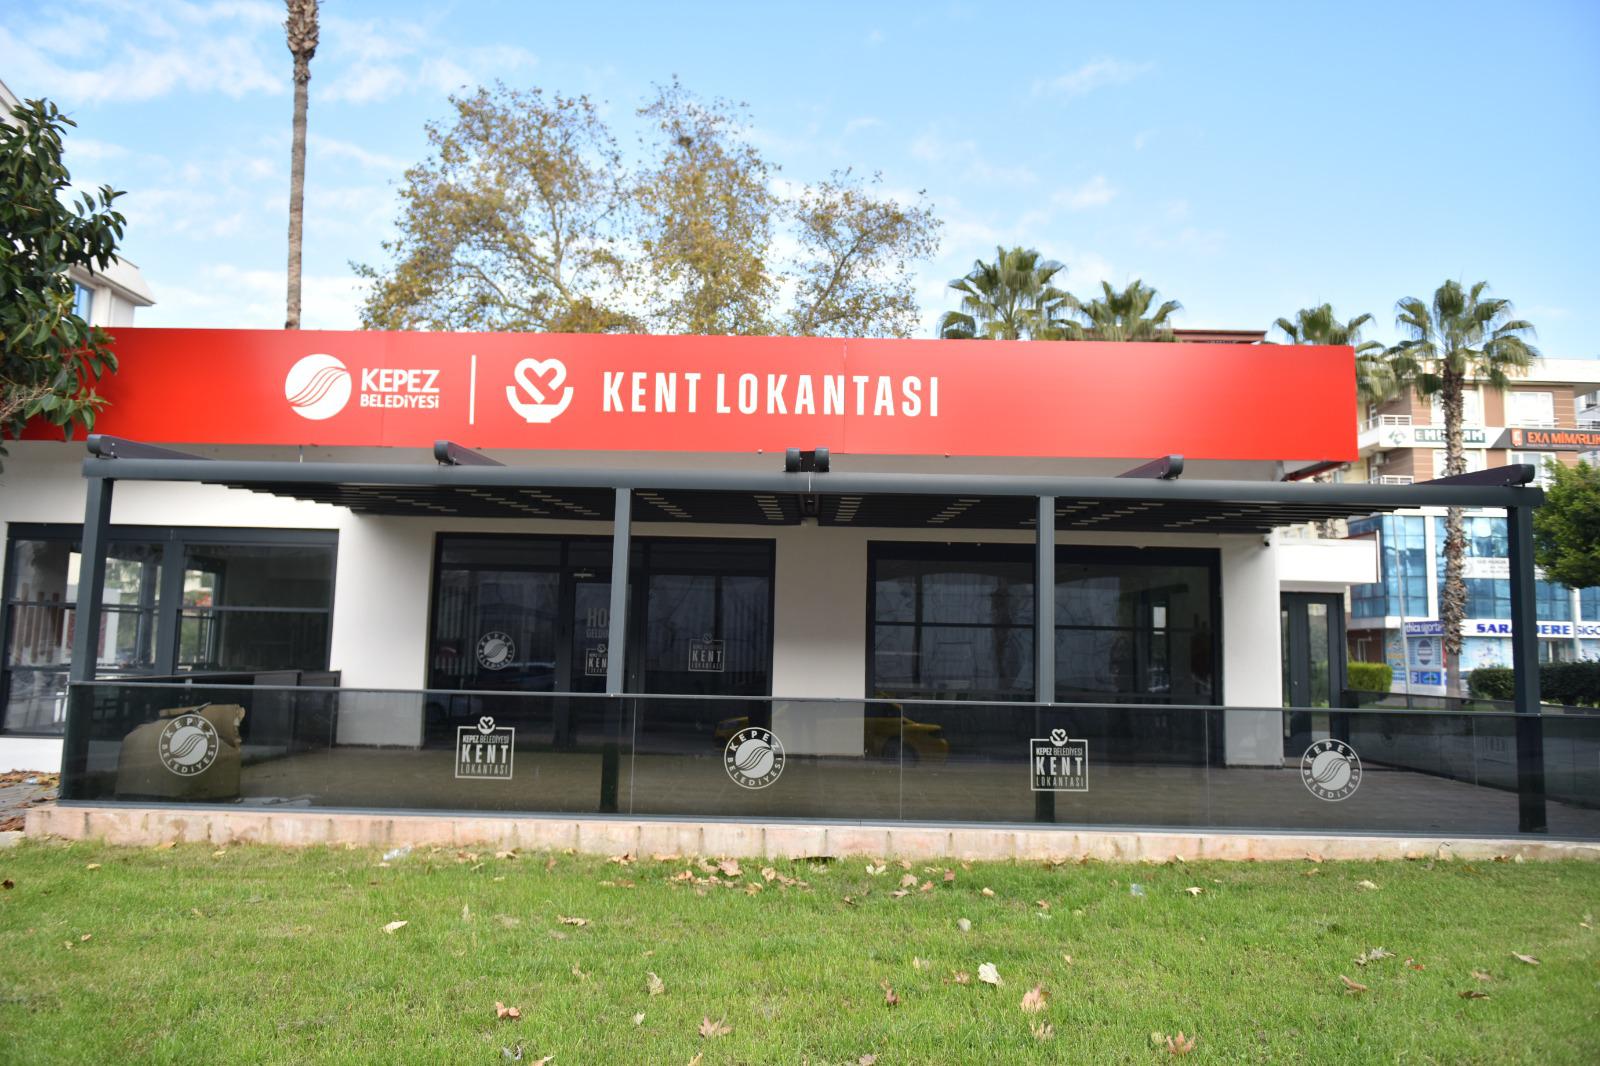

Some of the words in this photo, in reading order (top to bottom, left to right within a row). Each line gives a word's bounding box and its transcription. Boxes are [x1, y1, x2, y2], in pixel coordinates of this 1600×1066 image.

[361, 367, 440, 393] KEPEZ
[602, 371, 701, 413] KENT
[716, 372, 938, 417] LOKANTASI
[1527, 432, 1549, 444] EXA
[692, 650, 722, 662] KENT
[164, 717, 214, 738] KEPEZ
[462, 734, 479, 743] KEPEZ
[730, 730, 780, 751] KEPEZ
[461, 744, 509, 764] KENT
[1035, 747, 1052, 756] KEPEZ
[1305, 741, 1356, 764] KEPEZ
[460, 764, 508, 775] LOKANTASI
[1036, 756, 1083, 776] KENT
[1036, 776, 1084, 787] LOKANTASI
